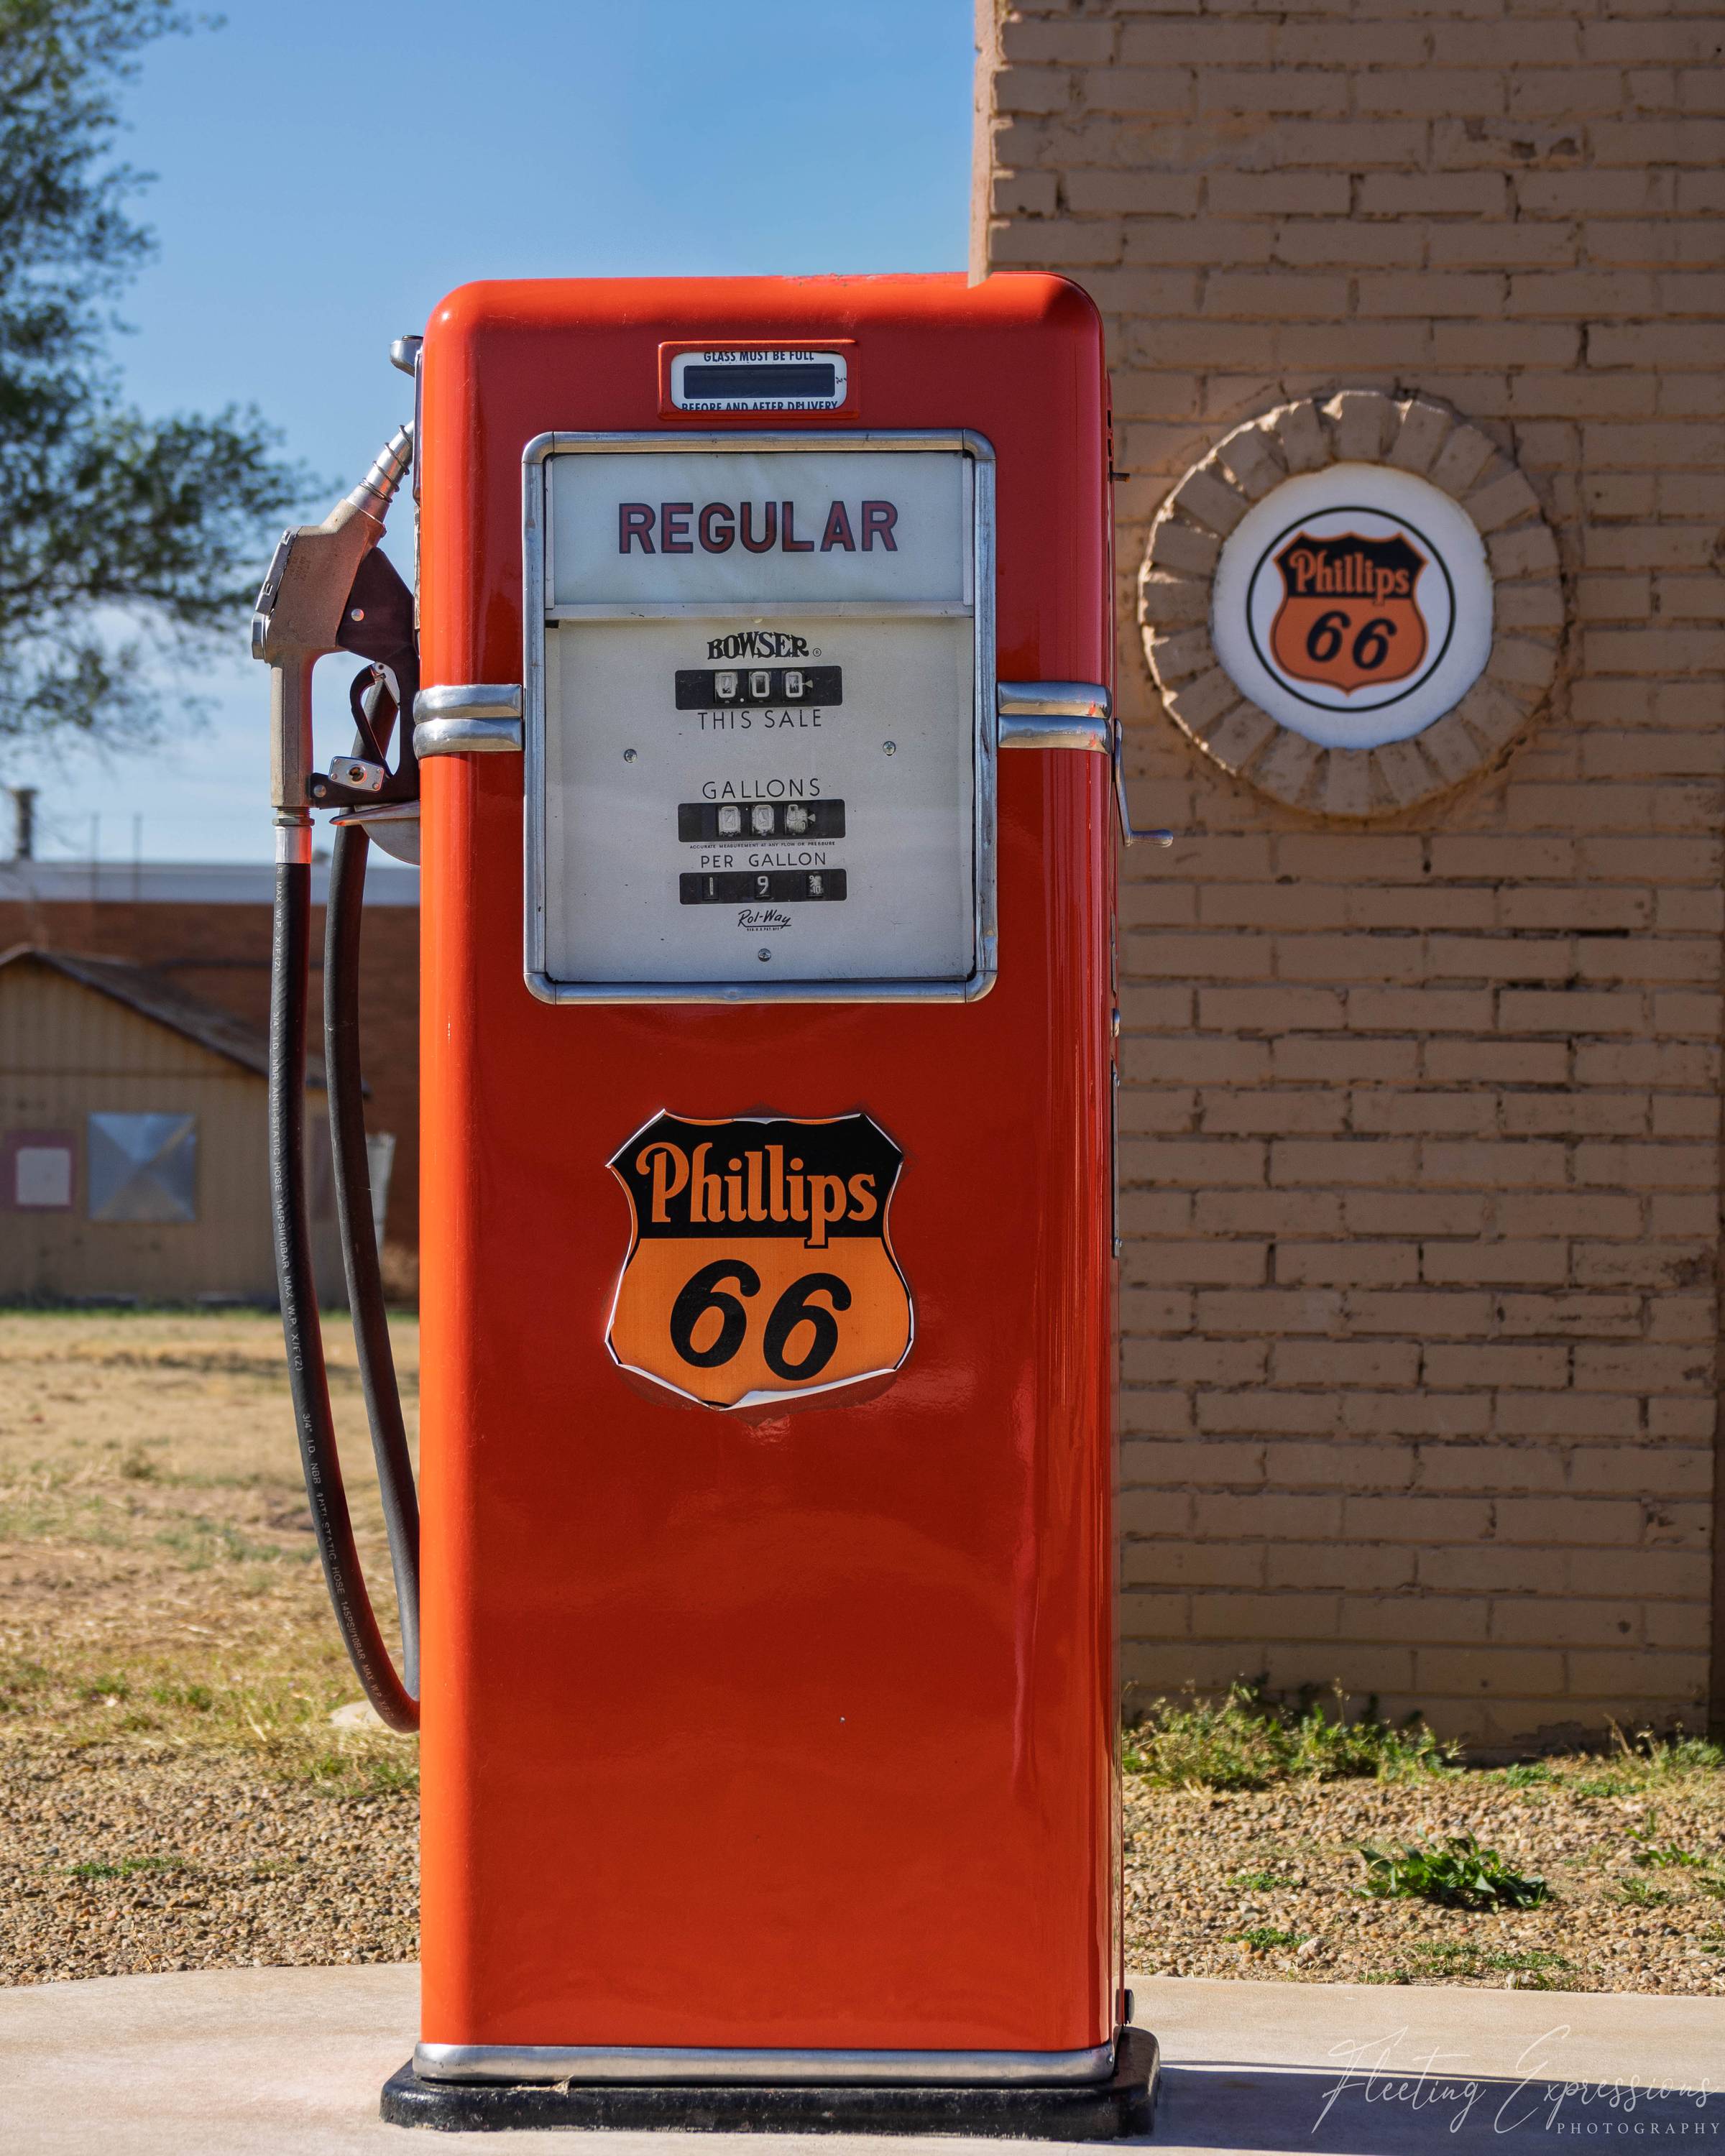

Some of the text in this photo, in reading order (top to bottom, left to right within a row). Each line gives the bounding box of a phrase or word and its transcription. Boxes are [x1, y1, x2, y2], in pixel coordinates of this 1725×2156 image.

[704, 351, 814, 362] GLASS MUST BE FULL
[681, 402, 722, 411] BEFORE
[726, 402, 749, 411] AND
[752, 401, 783, 410] AFTER
[619, 501, 898, 554] REGULAR
[1288, 548, 1410, 607] Phillips
[707, 631, 809, 660] BOWSER
[1306, 610, 1398, 671] 66
[697, 708, 822, 730] THIS SALE
[702, 778, 821, 799] GALLONS
[701, 852, 826, 869] PER GALLON
[737, 908, 792, 929] Rol-Way
[272, 1087, 281, 1156] ANTI-STATIC
[274, 1162, 282, 1191] HOSE
[635, 1142, 878, 1246] Phillips
[276, 1199, 290, 1269] 145PSI/10BAR
[284, 1276, 294, 1299] MAX
[288, 1305, 297, 1327] W.P.
[670, 1259, 852, 1381] 66
[303, 1413, 313, 1432] 3/4"
[310, 1462, 321, 1484] NBR
[331, 1567, 345, 1595] HOSE
[362, 1664, 374, 1680] MAX
